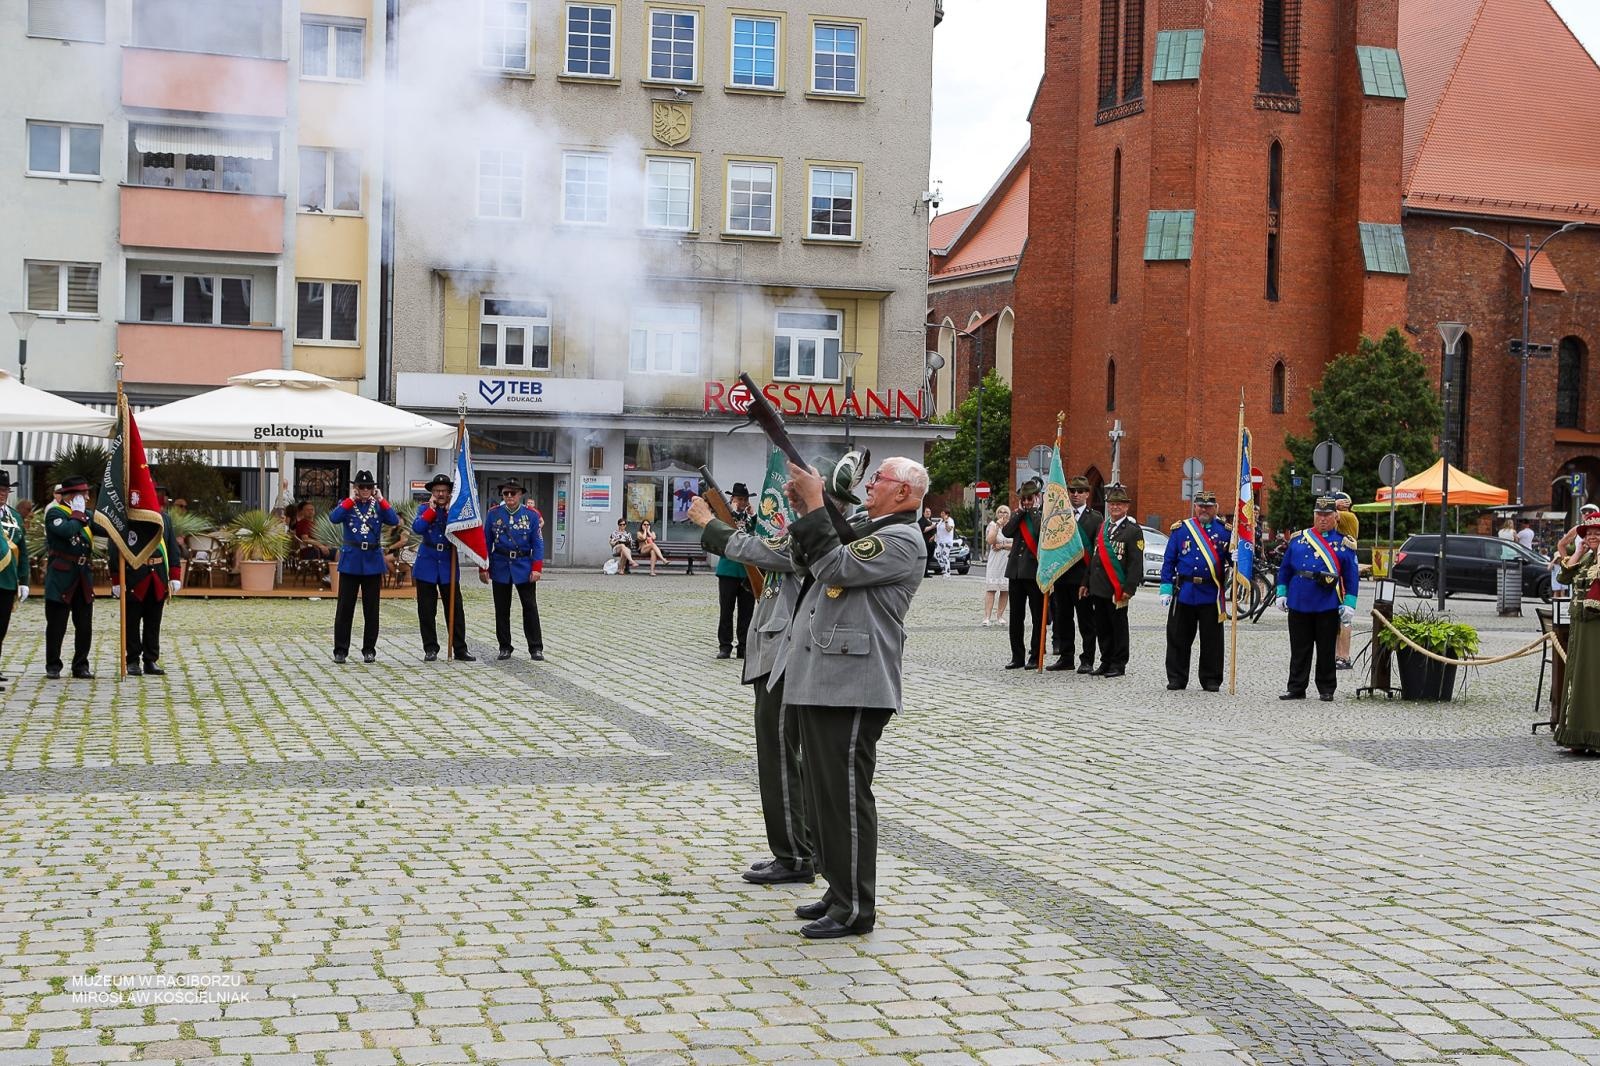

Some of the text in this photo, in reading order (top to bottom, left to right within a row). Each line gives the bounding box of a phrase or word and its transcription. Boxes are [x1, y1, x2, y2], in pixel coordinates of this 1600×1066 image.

[508, 381, 543, 395] TEB
[704, 381, 922, 418] ROSSMANN
[254, 424, 324, 440] gelatopiu
